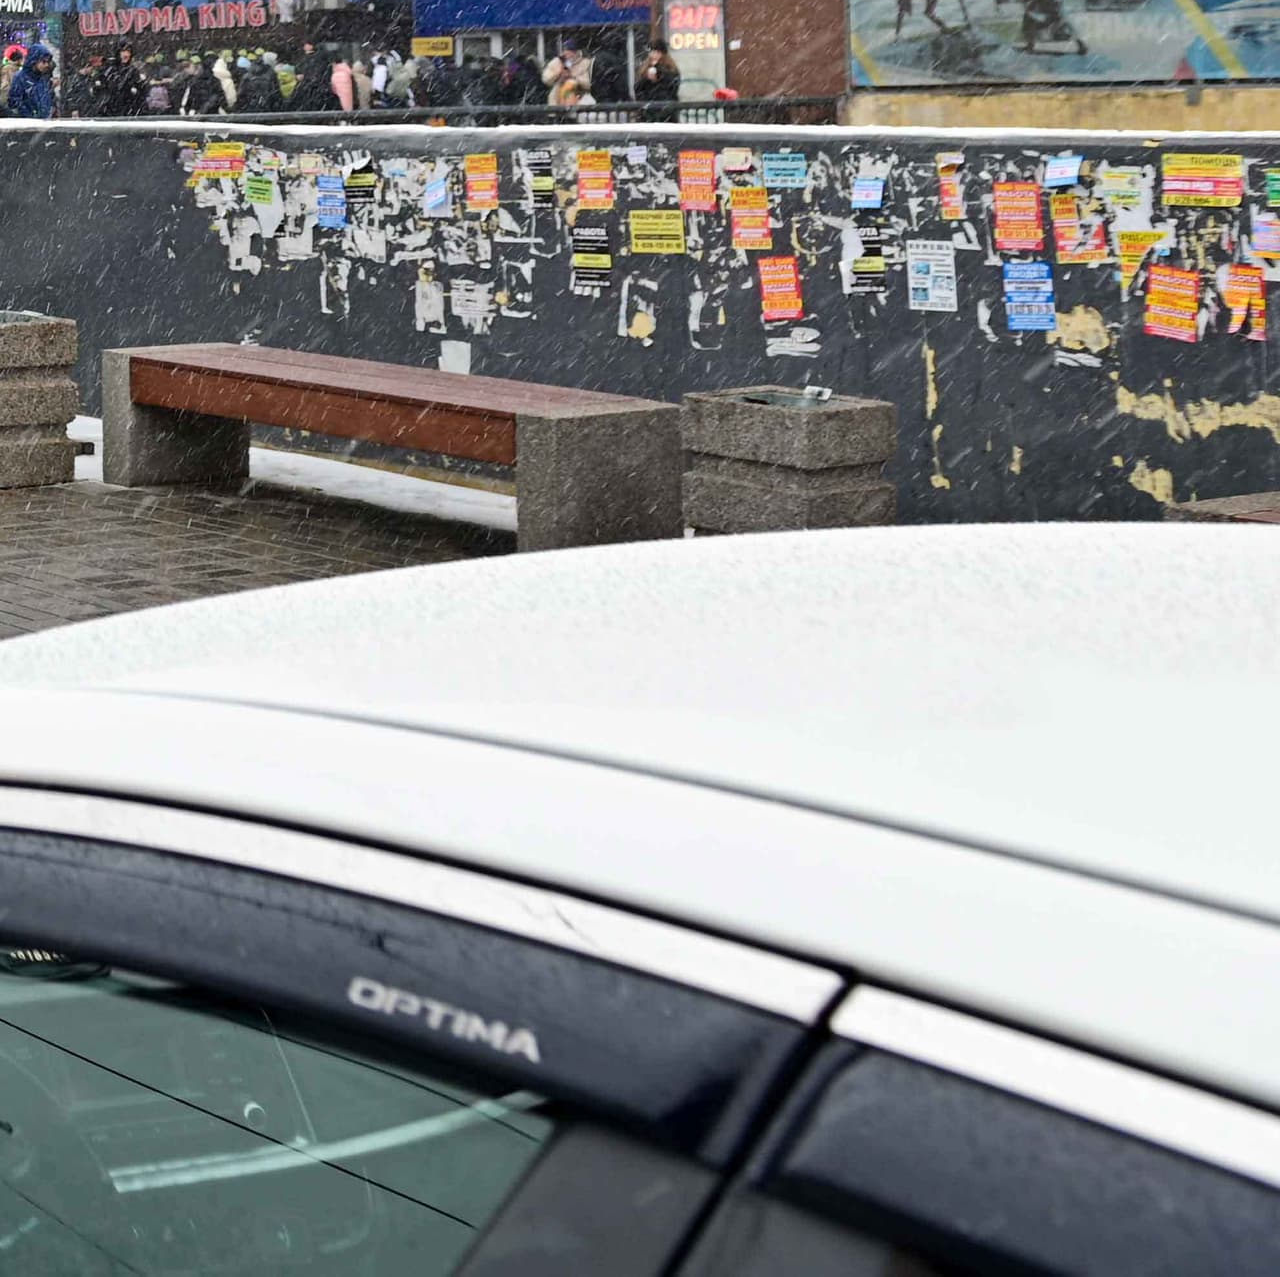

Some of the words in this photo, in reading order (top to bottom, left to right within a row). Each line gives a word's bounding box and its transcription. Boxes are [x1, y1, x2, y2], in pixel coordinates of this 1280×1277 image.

[78, 4, 191, 37] ШАУРМА
[669, 5, 719, 29] 24/7
[669, 33, 719, 50] OPEN
[347, 976, 540, 1064] OPTIMA
